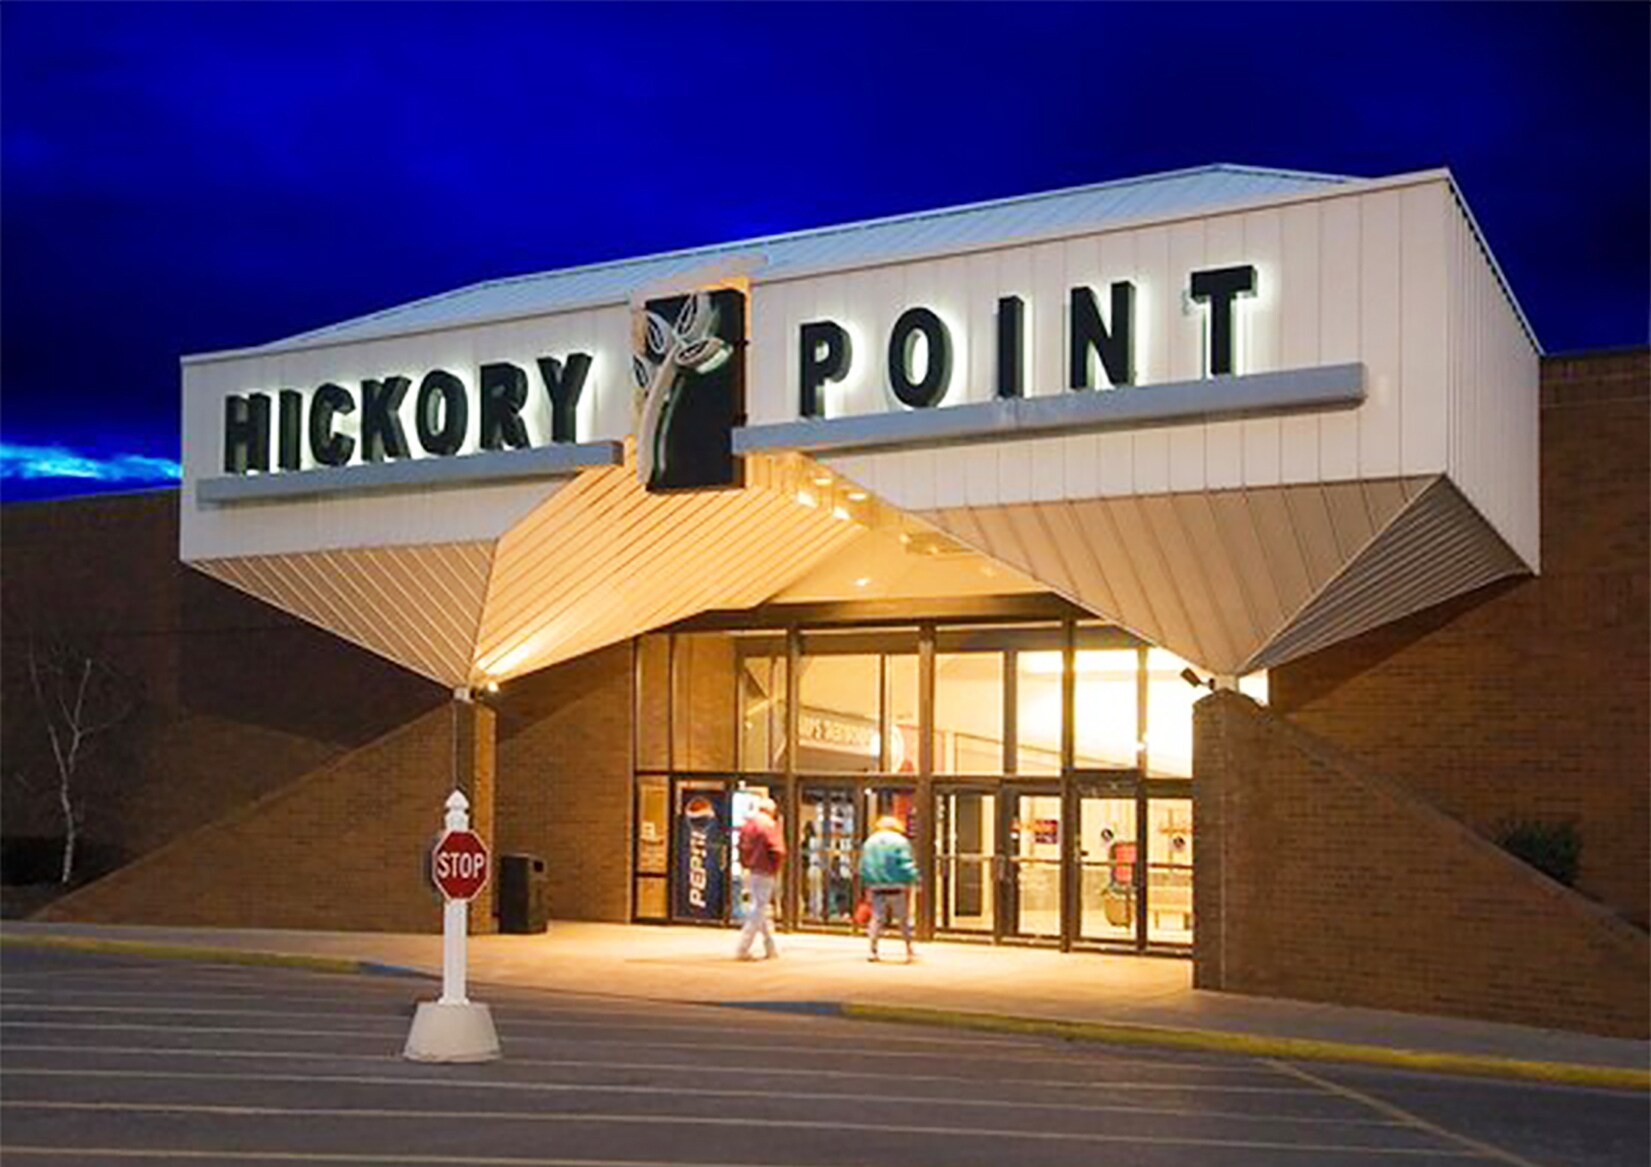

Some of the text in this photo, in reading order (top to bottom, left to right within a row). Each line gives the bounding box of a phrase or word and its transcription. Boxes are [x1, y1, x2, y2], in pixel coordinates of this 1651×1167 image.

[224, 264, 1259, 474] HICKORY POINT
[437, 852, 485, 879] STOP
